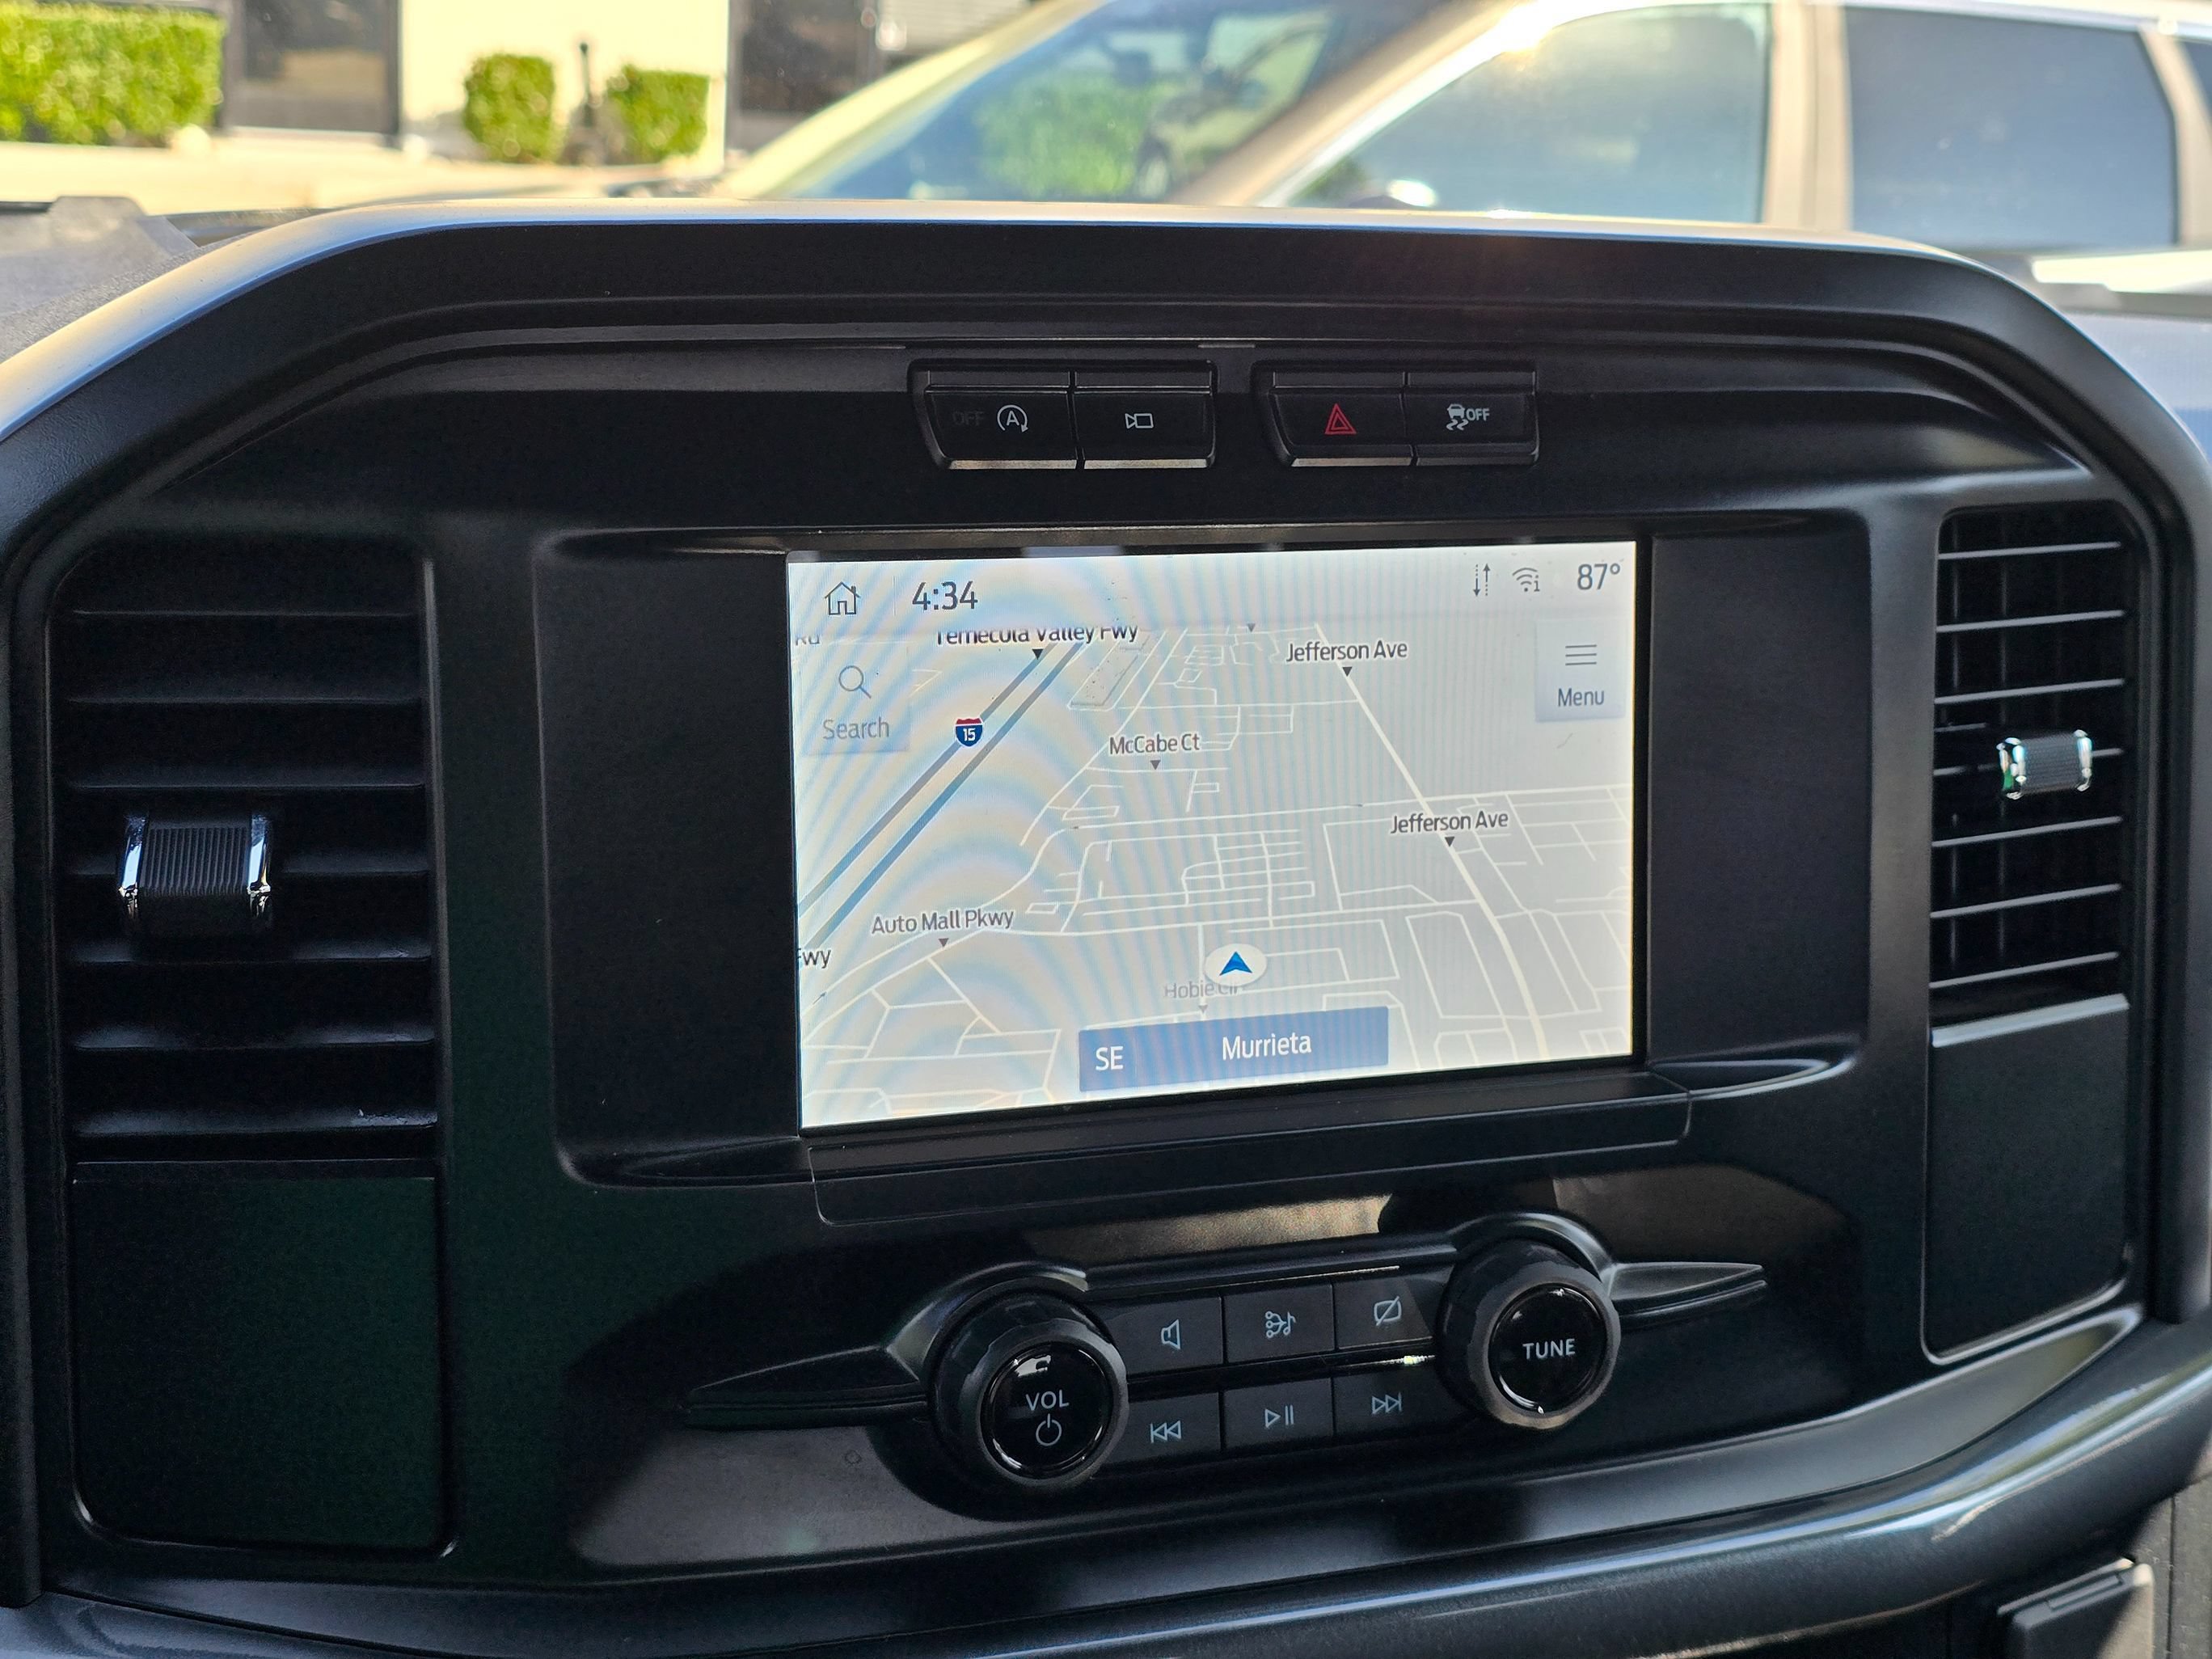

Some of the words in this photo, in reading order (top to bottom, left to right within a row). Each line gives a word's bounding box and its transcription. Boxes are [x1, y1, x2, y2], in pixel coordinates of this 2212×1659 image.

[1466, 407, 1490, 421] OFF
[912, 580, 978, 611] 4:34
[1036, 625, 1095, 644] Valley
[1285, 641, 1370, 663] Jefferson
[1374, 640, 1408, 659] Ave
[1557, 688, 1605, 707] Menu
[822, 716, 890, 741] Search
[962, 727, 977, 742] 15
[1109, 733, 1178, 755] McCabe
[1180, 733, 1201, 753] Ct
[1390, 812, 1471, 834] Jefferson
[1475, 810, 1509, 830] Ave
[871, 915, 918, 935] Auto
[922, 910, 961, 931] Mall
[965, 909, 1015, 931] Pkwy
[1164, 980, 1214, 999] Hobie
[1095, 1045, 1125, 1072] SE
[1222, 1032, 1312, 1062] Murrieta
[1522, 1337, 1577, 1361] TUNE
[1025, 1390, 1070, 1412] VOL
